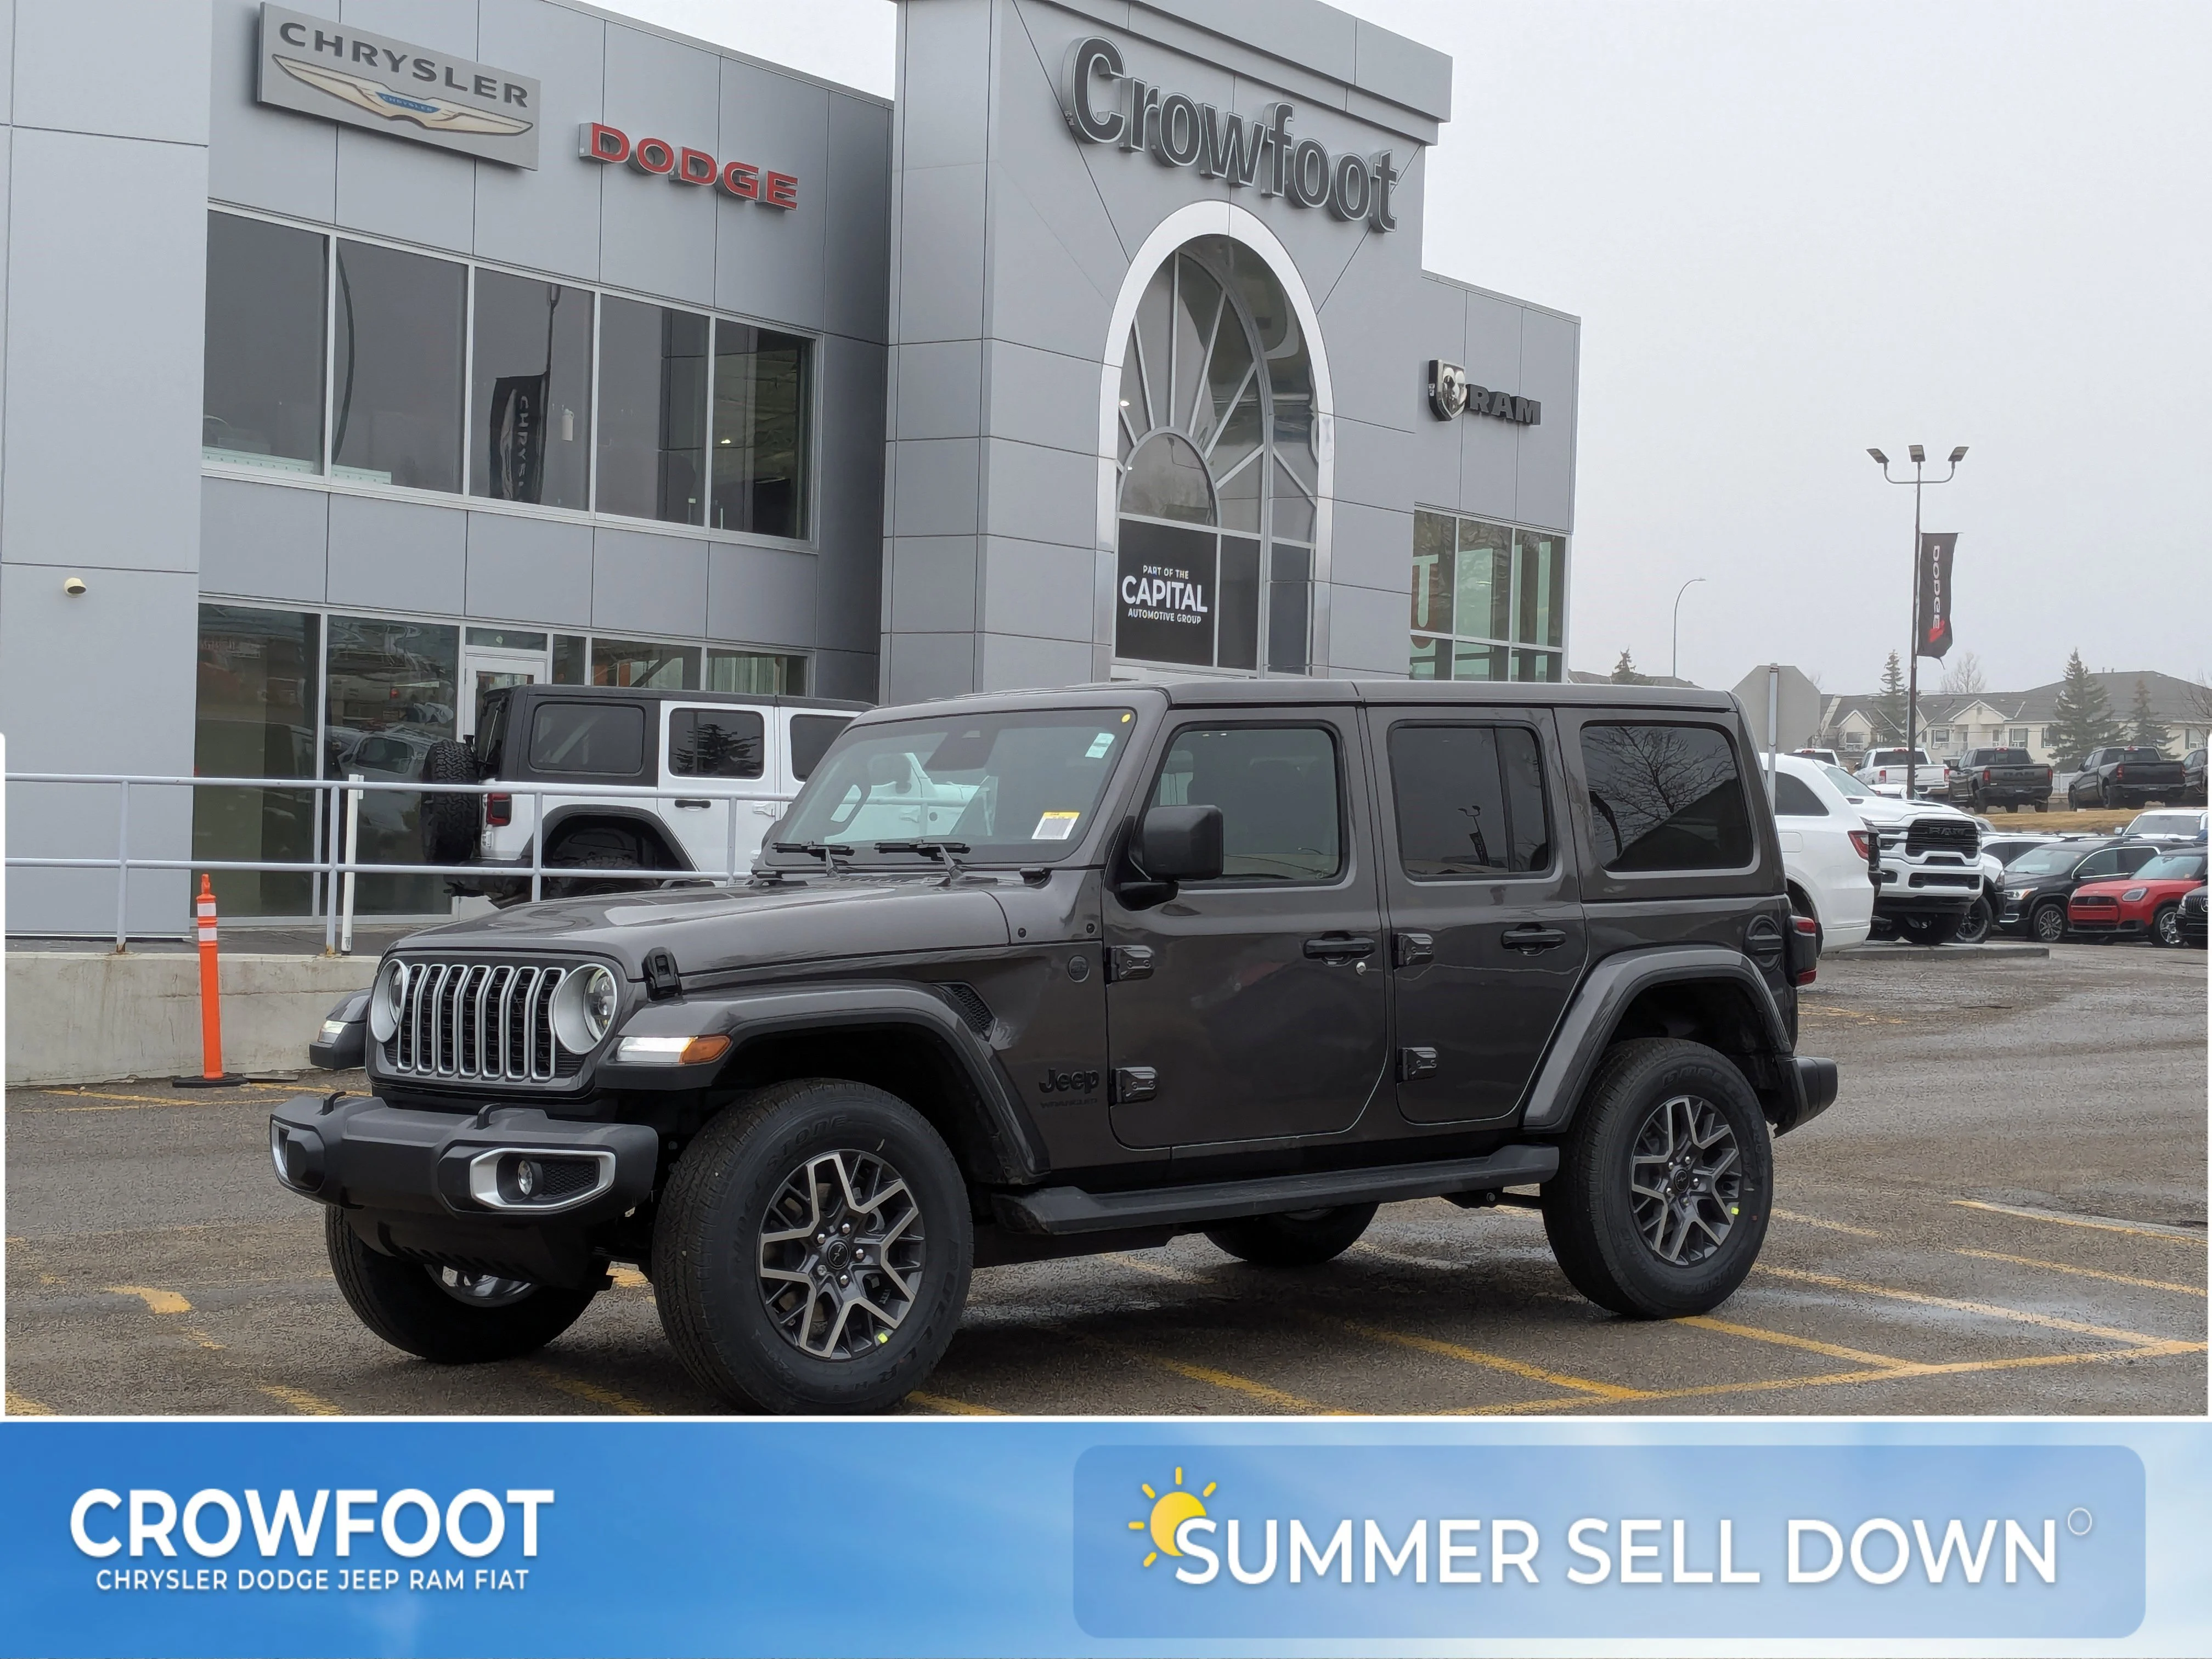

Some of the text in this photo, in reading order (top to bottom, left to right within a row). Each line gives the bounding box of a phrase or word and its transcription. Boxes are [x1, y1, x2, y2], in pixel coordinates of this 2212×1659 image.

[279, 22, 528, 108] CHRYSLER
[1065, 36, 1398, 233] Crowfoot
[588, 122, 799, 211] DODGE
[1467, 383, 1541, 425] RAM
[1143, 565, 1189, 579] PART OF THE
[1122, 575, 1208, 613] CAPITAL
[1128, 608, 1202, 624] AUTOMOTIVE GROUP
[1039, 1068, 1099, 1094] Jeep
